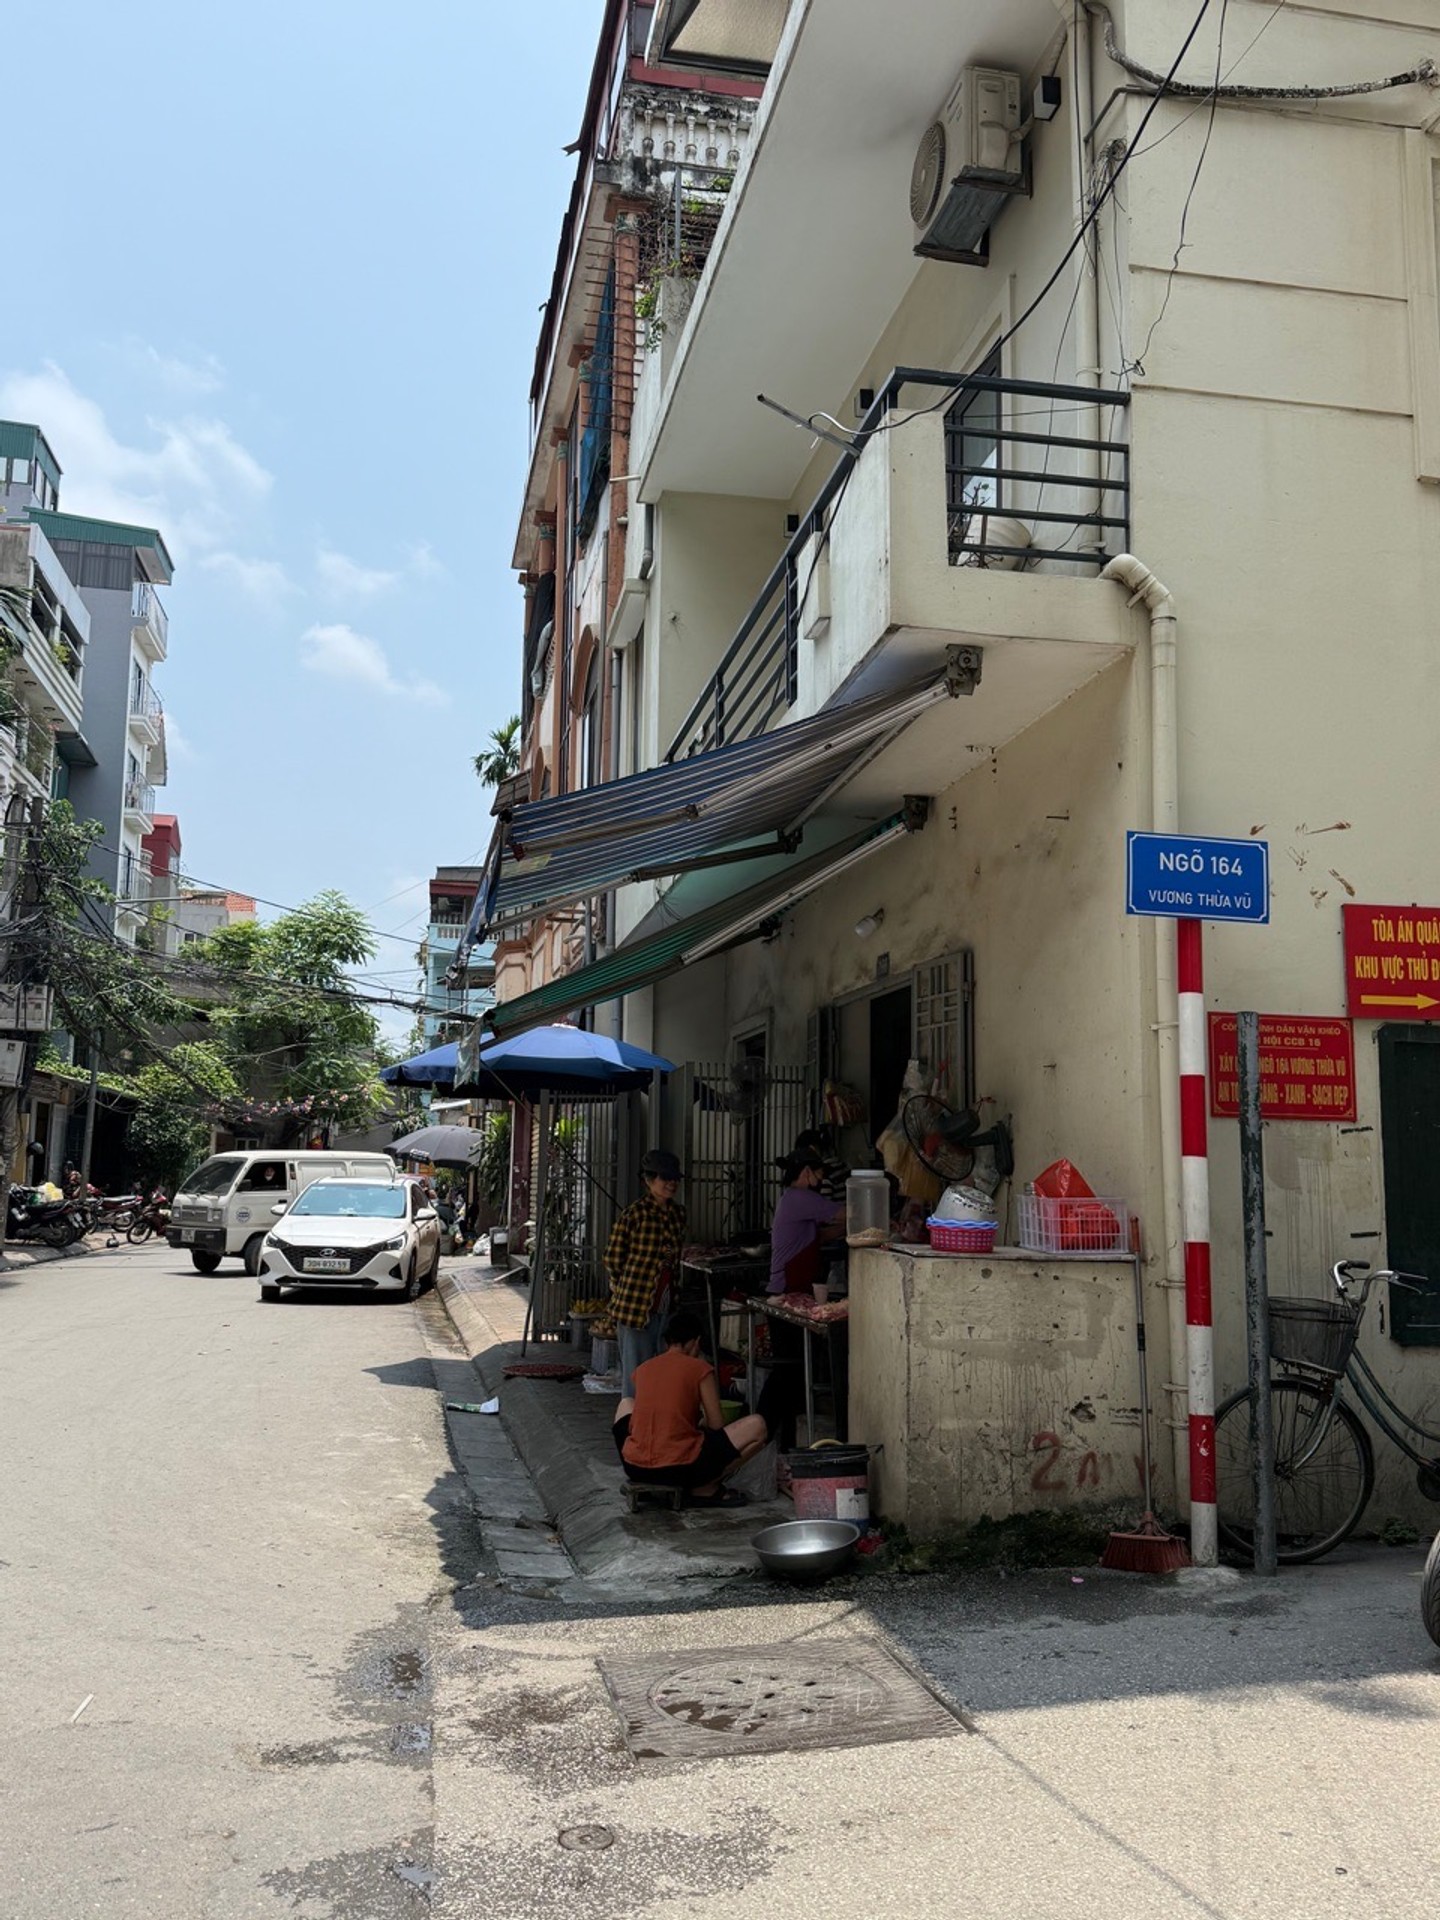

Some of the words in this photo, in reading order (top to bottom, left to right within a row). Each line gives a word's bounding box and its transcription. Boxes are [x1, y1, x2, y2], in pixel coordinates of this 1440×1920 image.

[1159, 849, 1204, 873] NGÕ
[1210, 856, 1243, 876] 164
[1148, 890, 1193, 905] VƯƠNG
[1197, 889, 1232, 908] THỪA
[1233, 892, 1251, 909] VŨ
[1371, 913, 1395, 942] TÒA
[1397, 915, 1414, 943] ÁN
[1416, 917, 1440, 946] QUÂ
[1354, 955, 1379, 979] KHU
[1381, 955, 1404, 985] VỰC
[1406, 951, 1429, 980] THỦ
[1431, 958, 1440, 980] Đ
